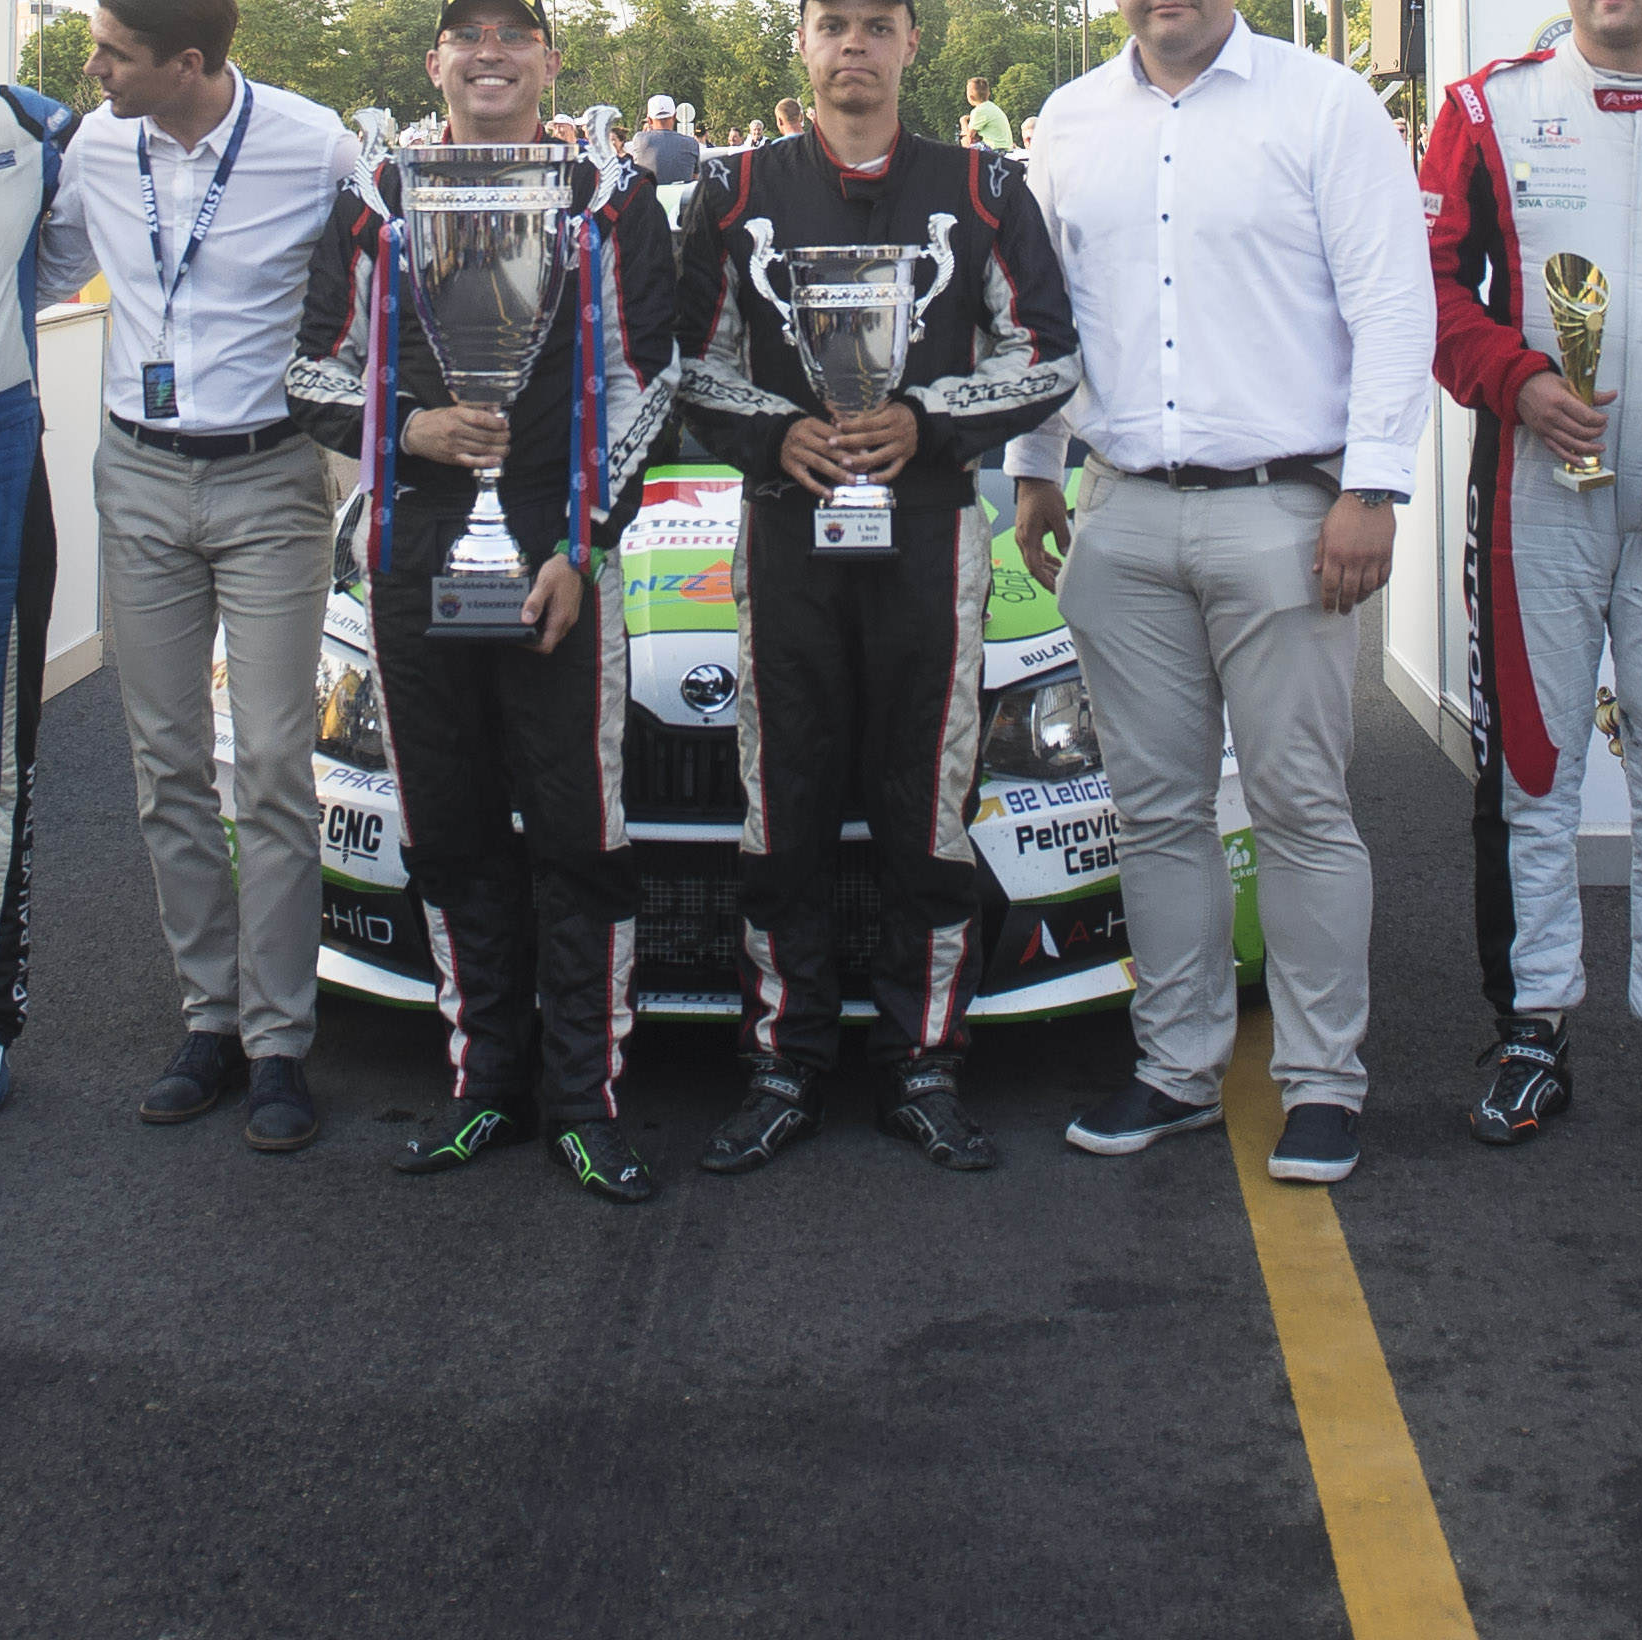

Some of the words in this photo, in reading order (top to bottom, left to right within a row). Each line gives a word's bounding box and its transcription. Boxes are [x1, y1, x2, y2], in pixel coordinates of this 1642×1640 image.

[1456, 83, 1486, 125] sparco
[141, 174, 160, 235] MNASZ
[193, 180, 226, 241] MNASZ
[1517, 199, 1543, 209] SIVA
[1545, 199, 1587, 210] GROUP
[1006, 788, 1041, 815] 92
[327, 804, 384, 855] CNC
